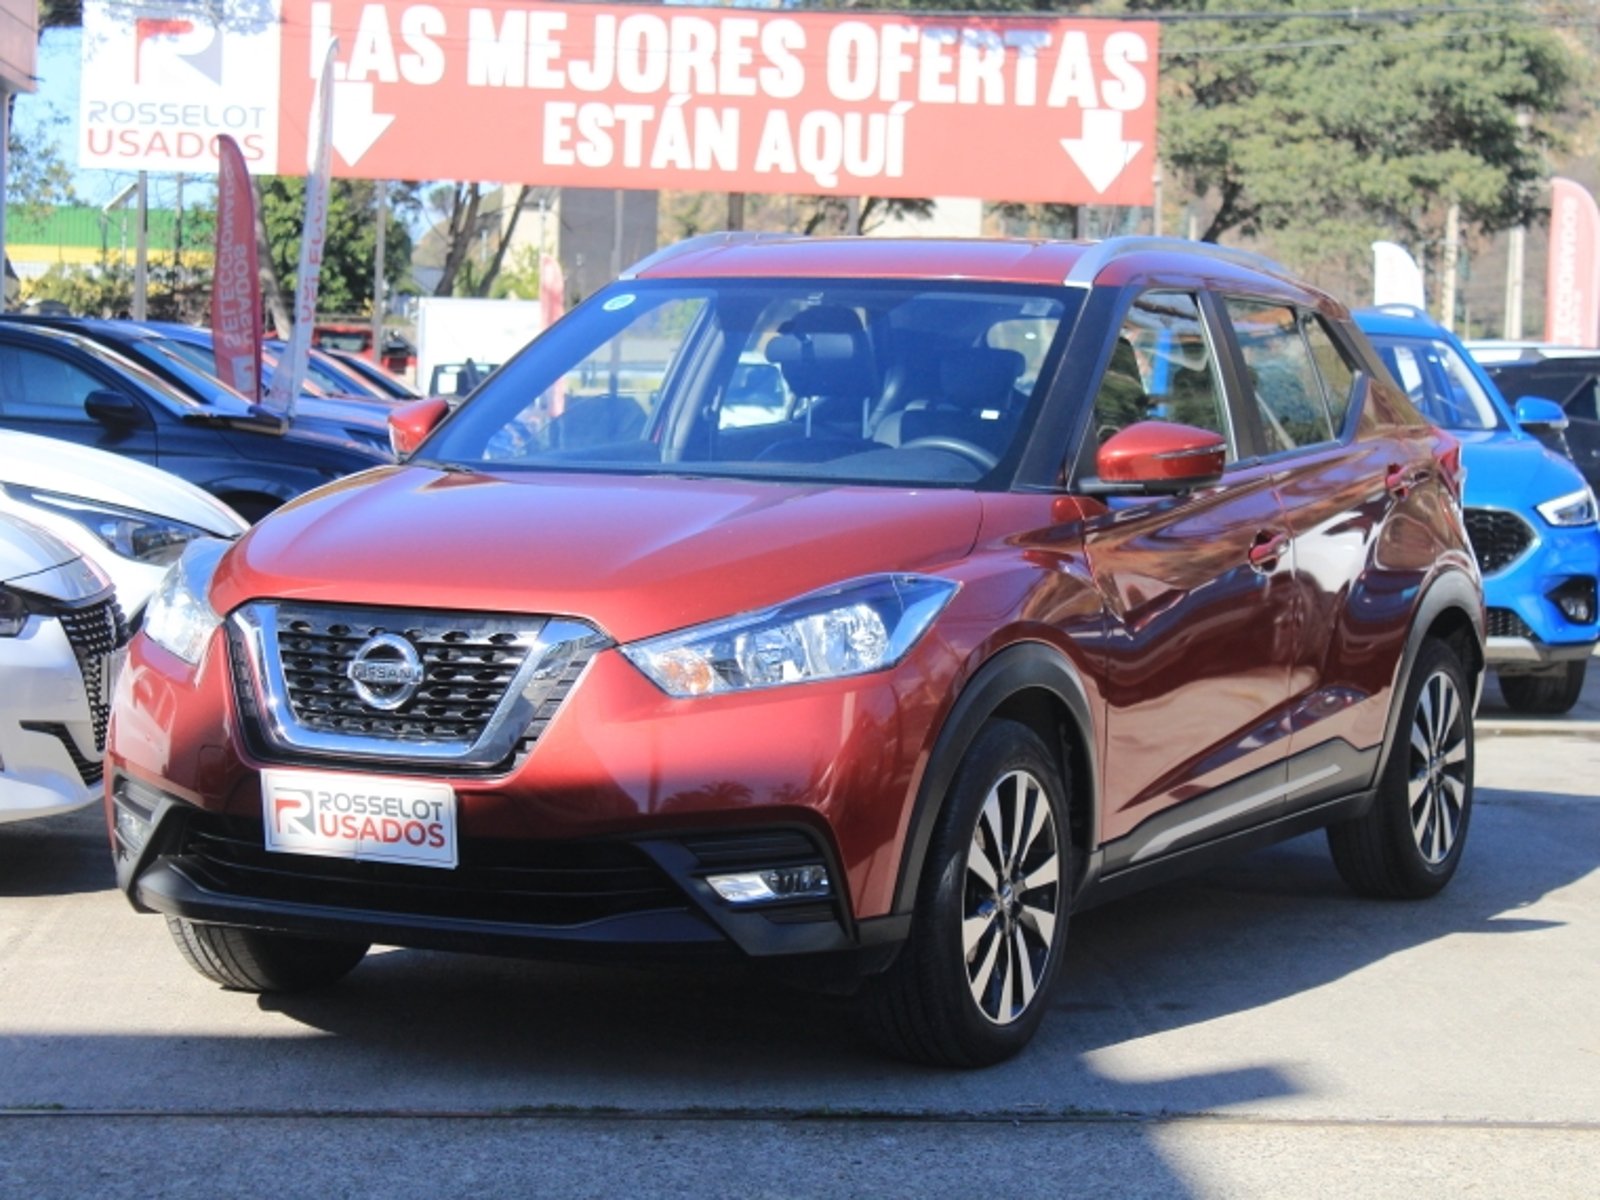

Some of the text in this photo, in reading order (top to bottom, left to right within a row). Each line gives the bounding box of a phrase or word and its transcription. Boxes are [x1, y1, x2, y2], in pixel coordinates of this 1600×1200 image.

[310, 1, 1148, 111] LAS MEJORES OFERTAS
[87, 100, 266, 129] ROSSELOT
[543, 94, 915, 188] ESTÁN AQUÍ
[317, 791, 443, 822] ROSSELOT
[318, 812, 446, 849] USADOS
